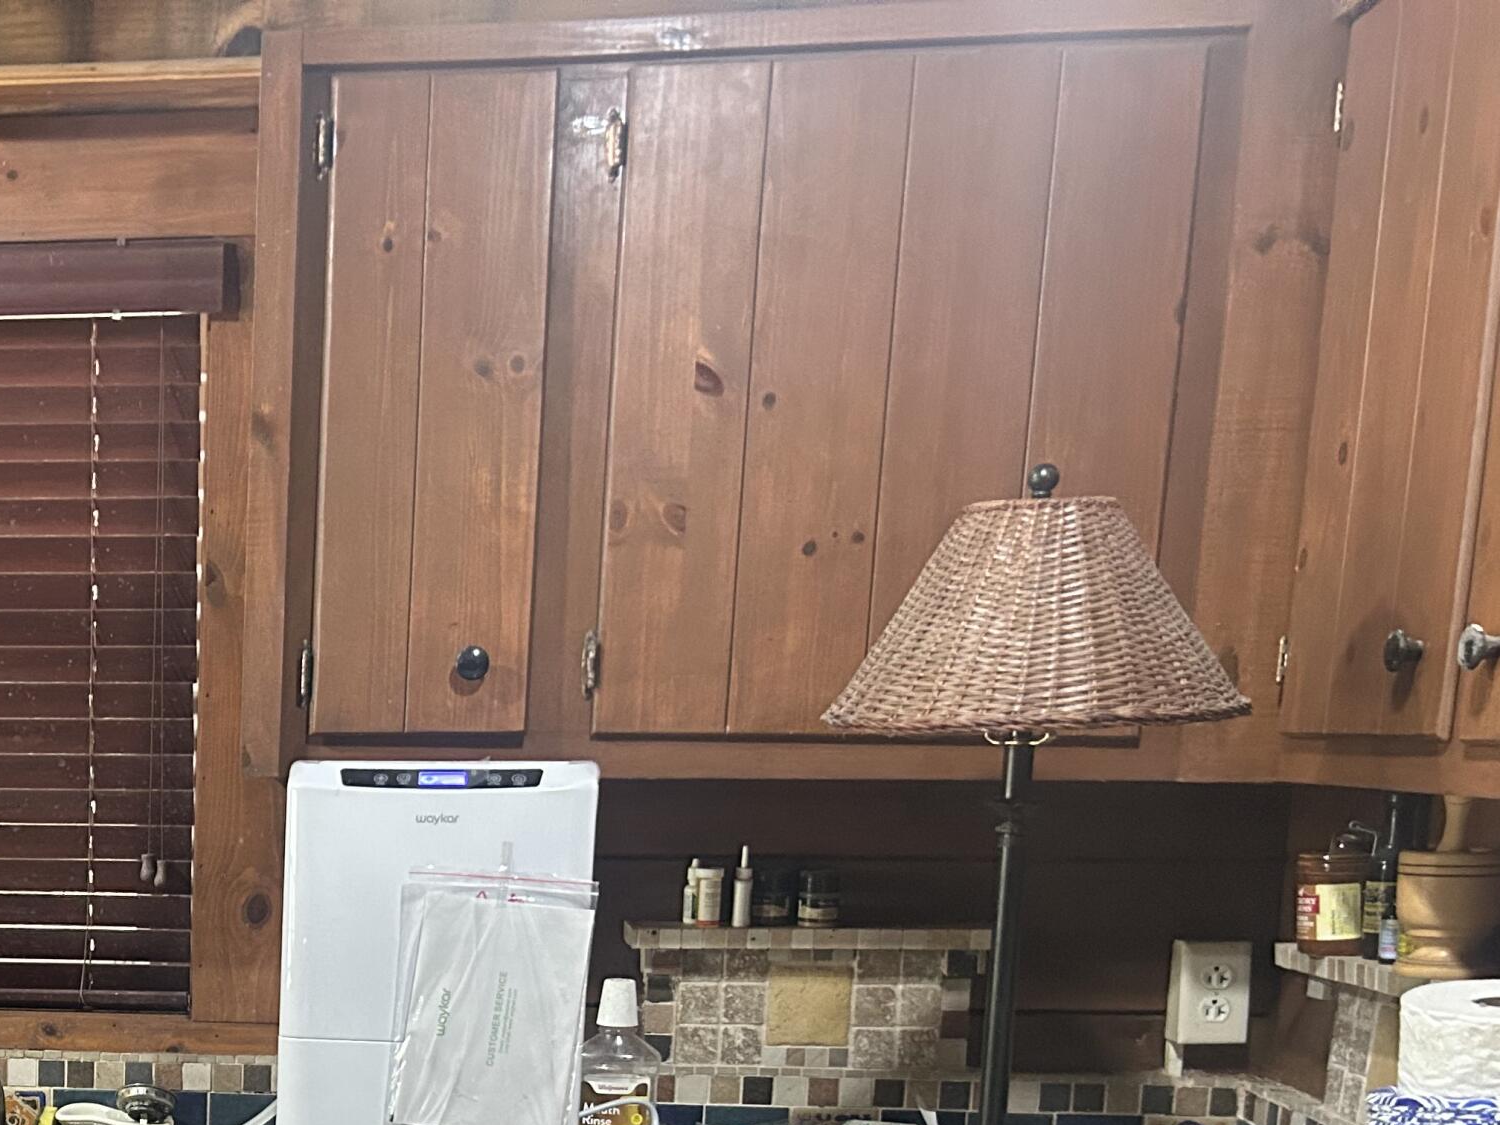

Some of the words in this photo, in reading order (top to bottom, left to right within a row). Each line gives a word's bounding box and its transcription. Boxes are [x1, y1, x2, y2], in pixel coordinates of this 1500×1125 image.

[415, 813, 459, 826] waykar
[436, 988, 451, 1036] waykar
[486, 1014, 501, 1067] CUSTOMER
[494, 971, 508, 1012] SERVICE
[582, 1115, 612, 1125] Rinse
